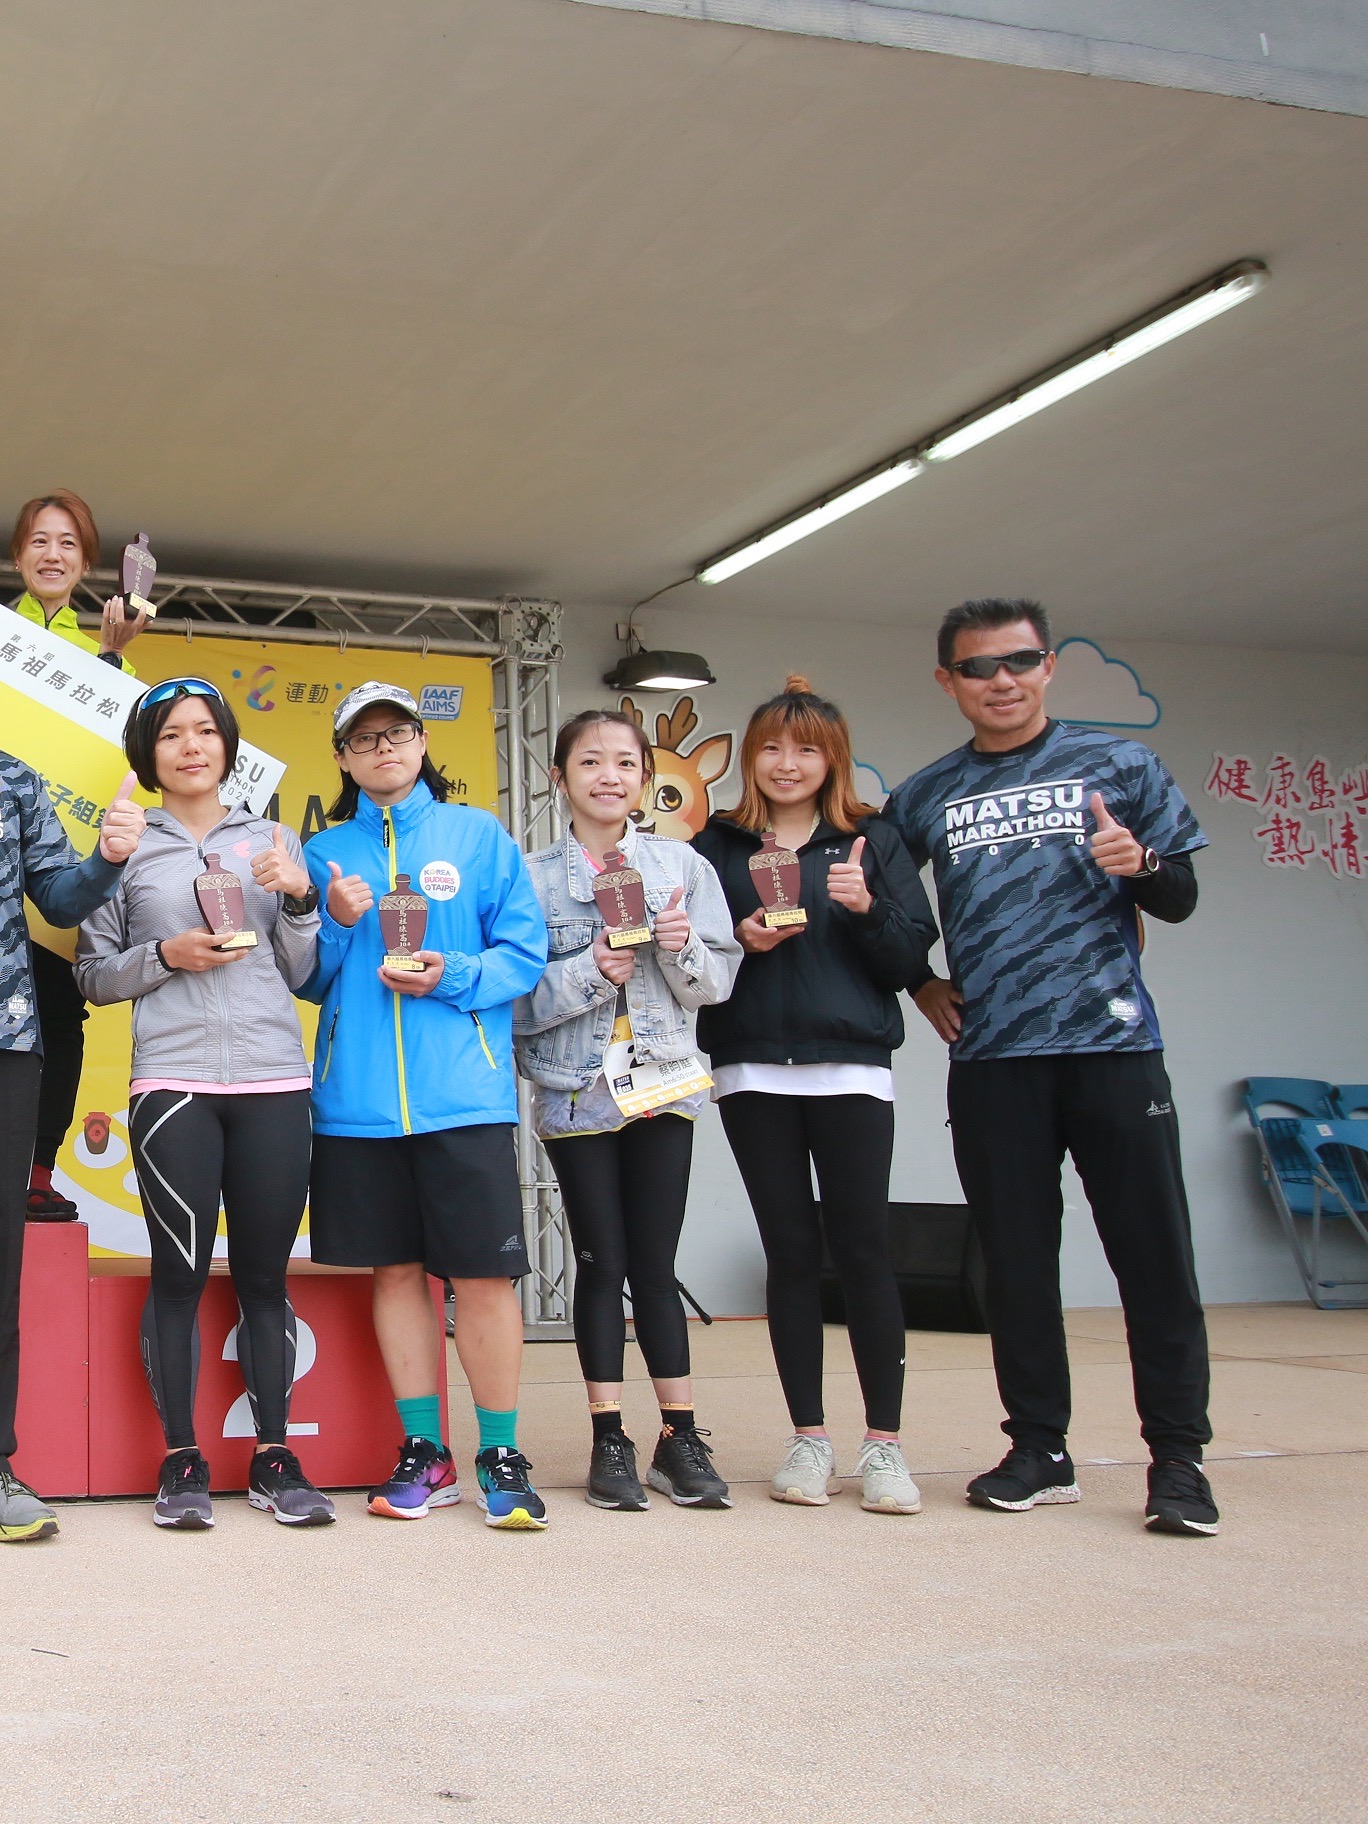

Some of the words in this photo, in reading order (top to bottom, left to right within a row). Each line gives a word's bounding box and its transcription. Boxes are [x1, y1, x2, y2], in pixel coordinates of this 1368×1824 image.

[423, 688, 460, 701] IAAF
[422, 700, 456, 713] AIMS
[945, 785, 1084, 831] MATSU
[946, 811, 1083, 848] MARATHON
[950, 834, 1085, 866] 2020
[424, 876, 455, 885] BUDDIES
